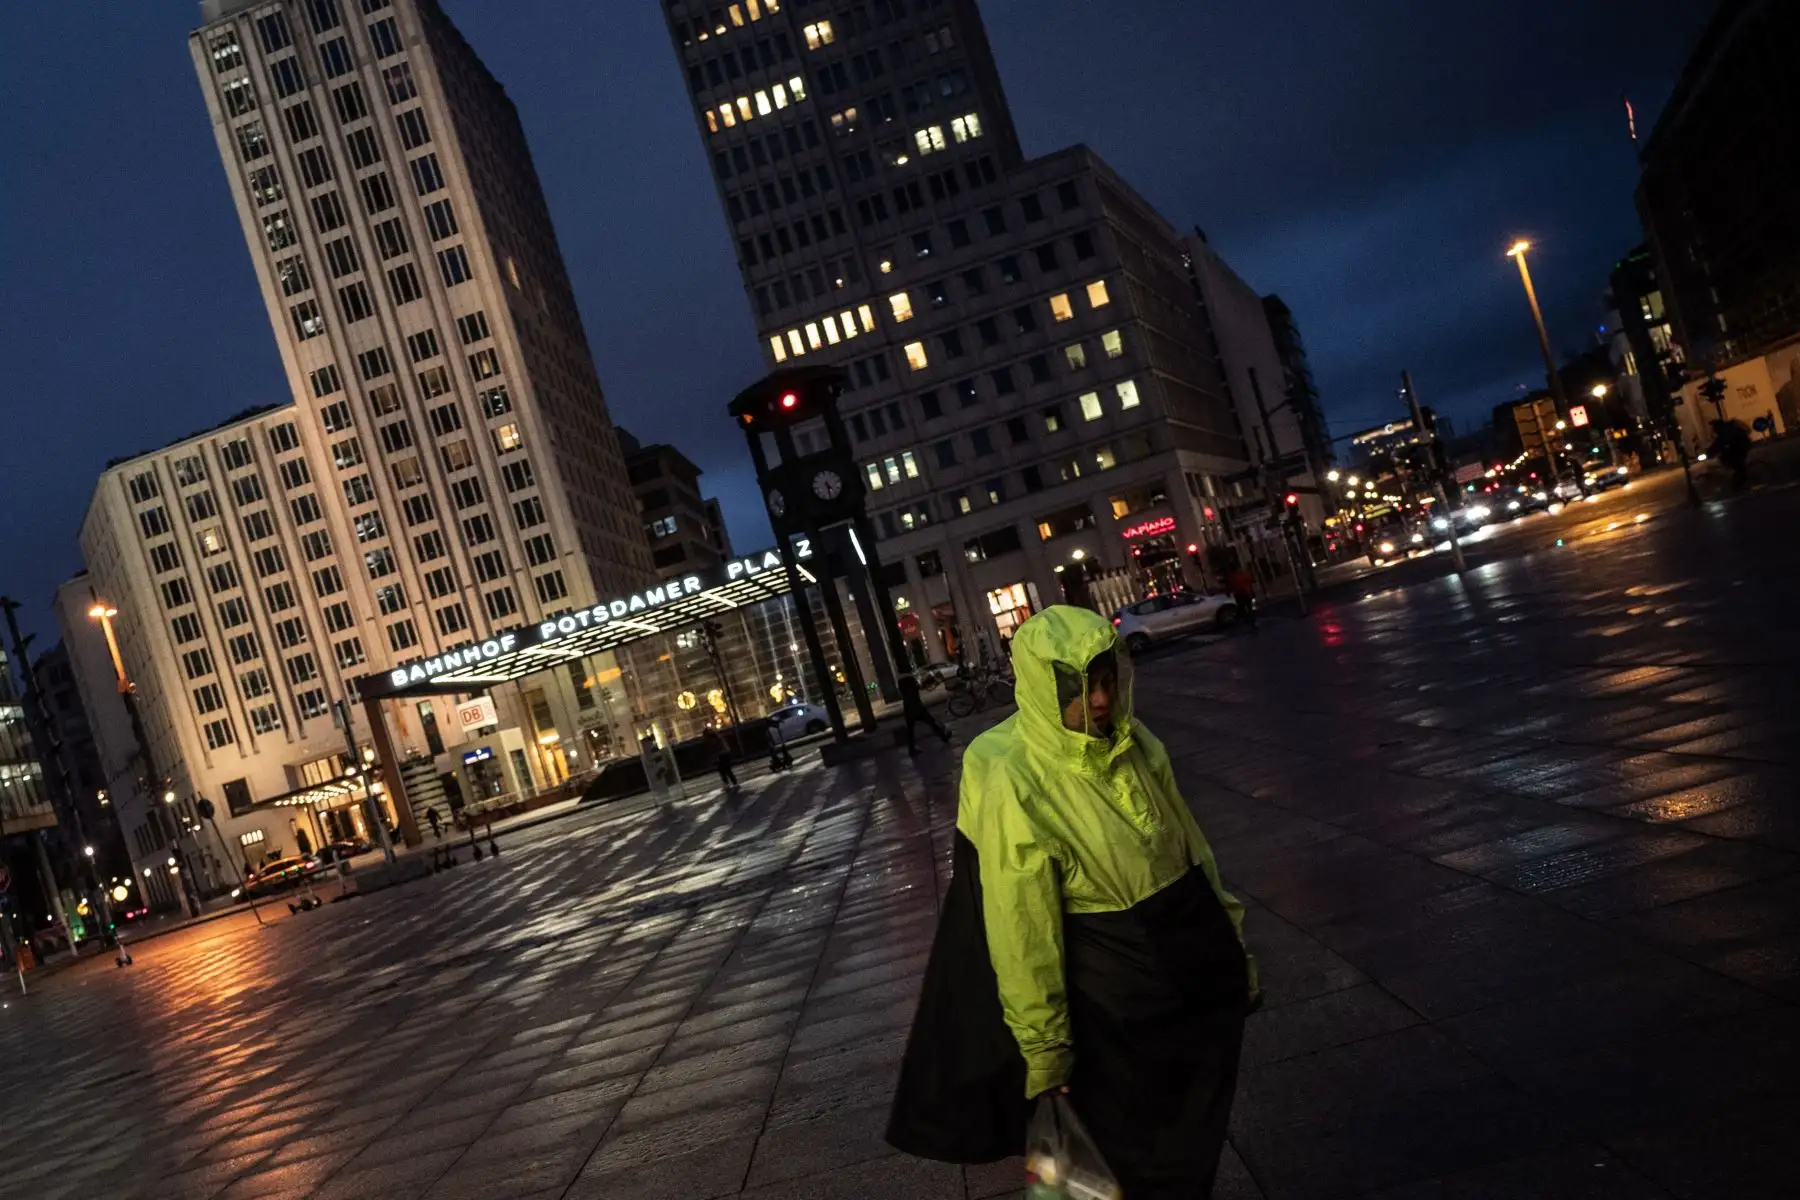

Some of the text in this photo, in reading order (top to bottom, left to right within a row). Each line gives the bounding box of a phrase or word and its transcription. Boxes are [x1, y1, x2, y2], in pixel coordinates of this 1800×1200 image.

[1122, 517, 1174, 538] VAPIANO
[391, 539, 813, 687] BAHNHOF POTSDAMER PLAZ
[463, 708, 480, 722] DB
